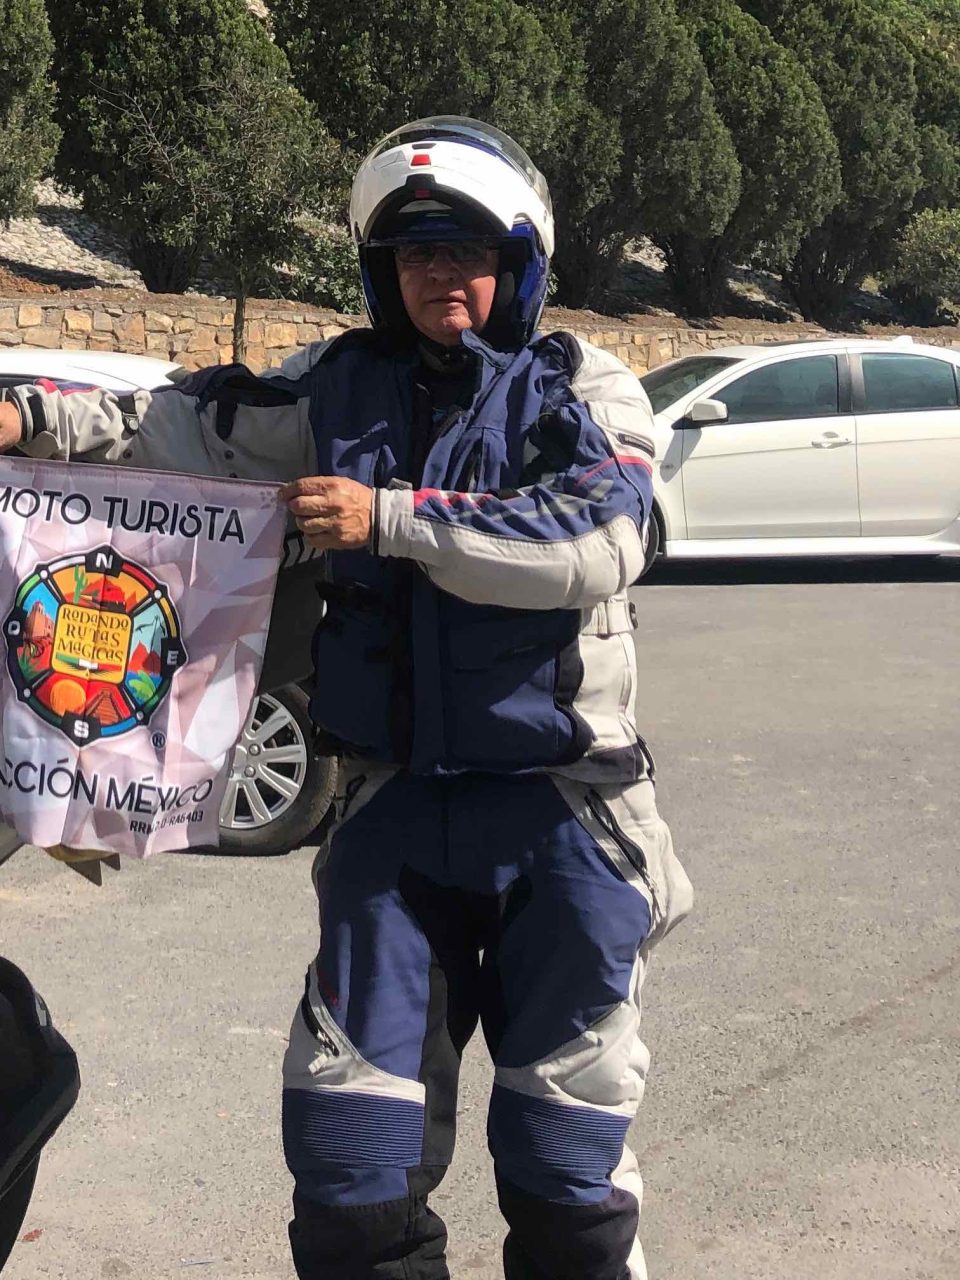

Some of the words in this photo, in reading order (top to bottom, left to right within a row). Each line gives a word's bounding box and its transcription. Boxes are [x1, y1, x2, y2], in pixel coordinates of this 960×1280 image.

[103, 496, 245, 544] TURISTA
[96, 552, 113, 569] N
[167, 650, 179, 666] E
[74, 720, 89, 739] S
[106, 776, 213, 815] MÉXICO
